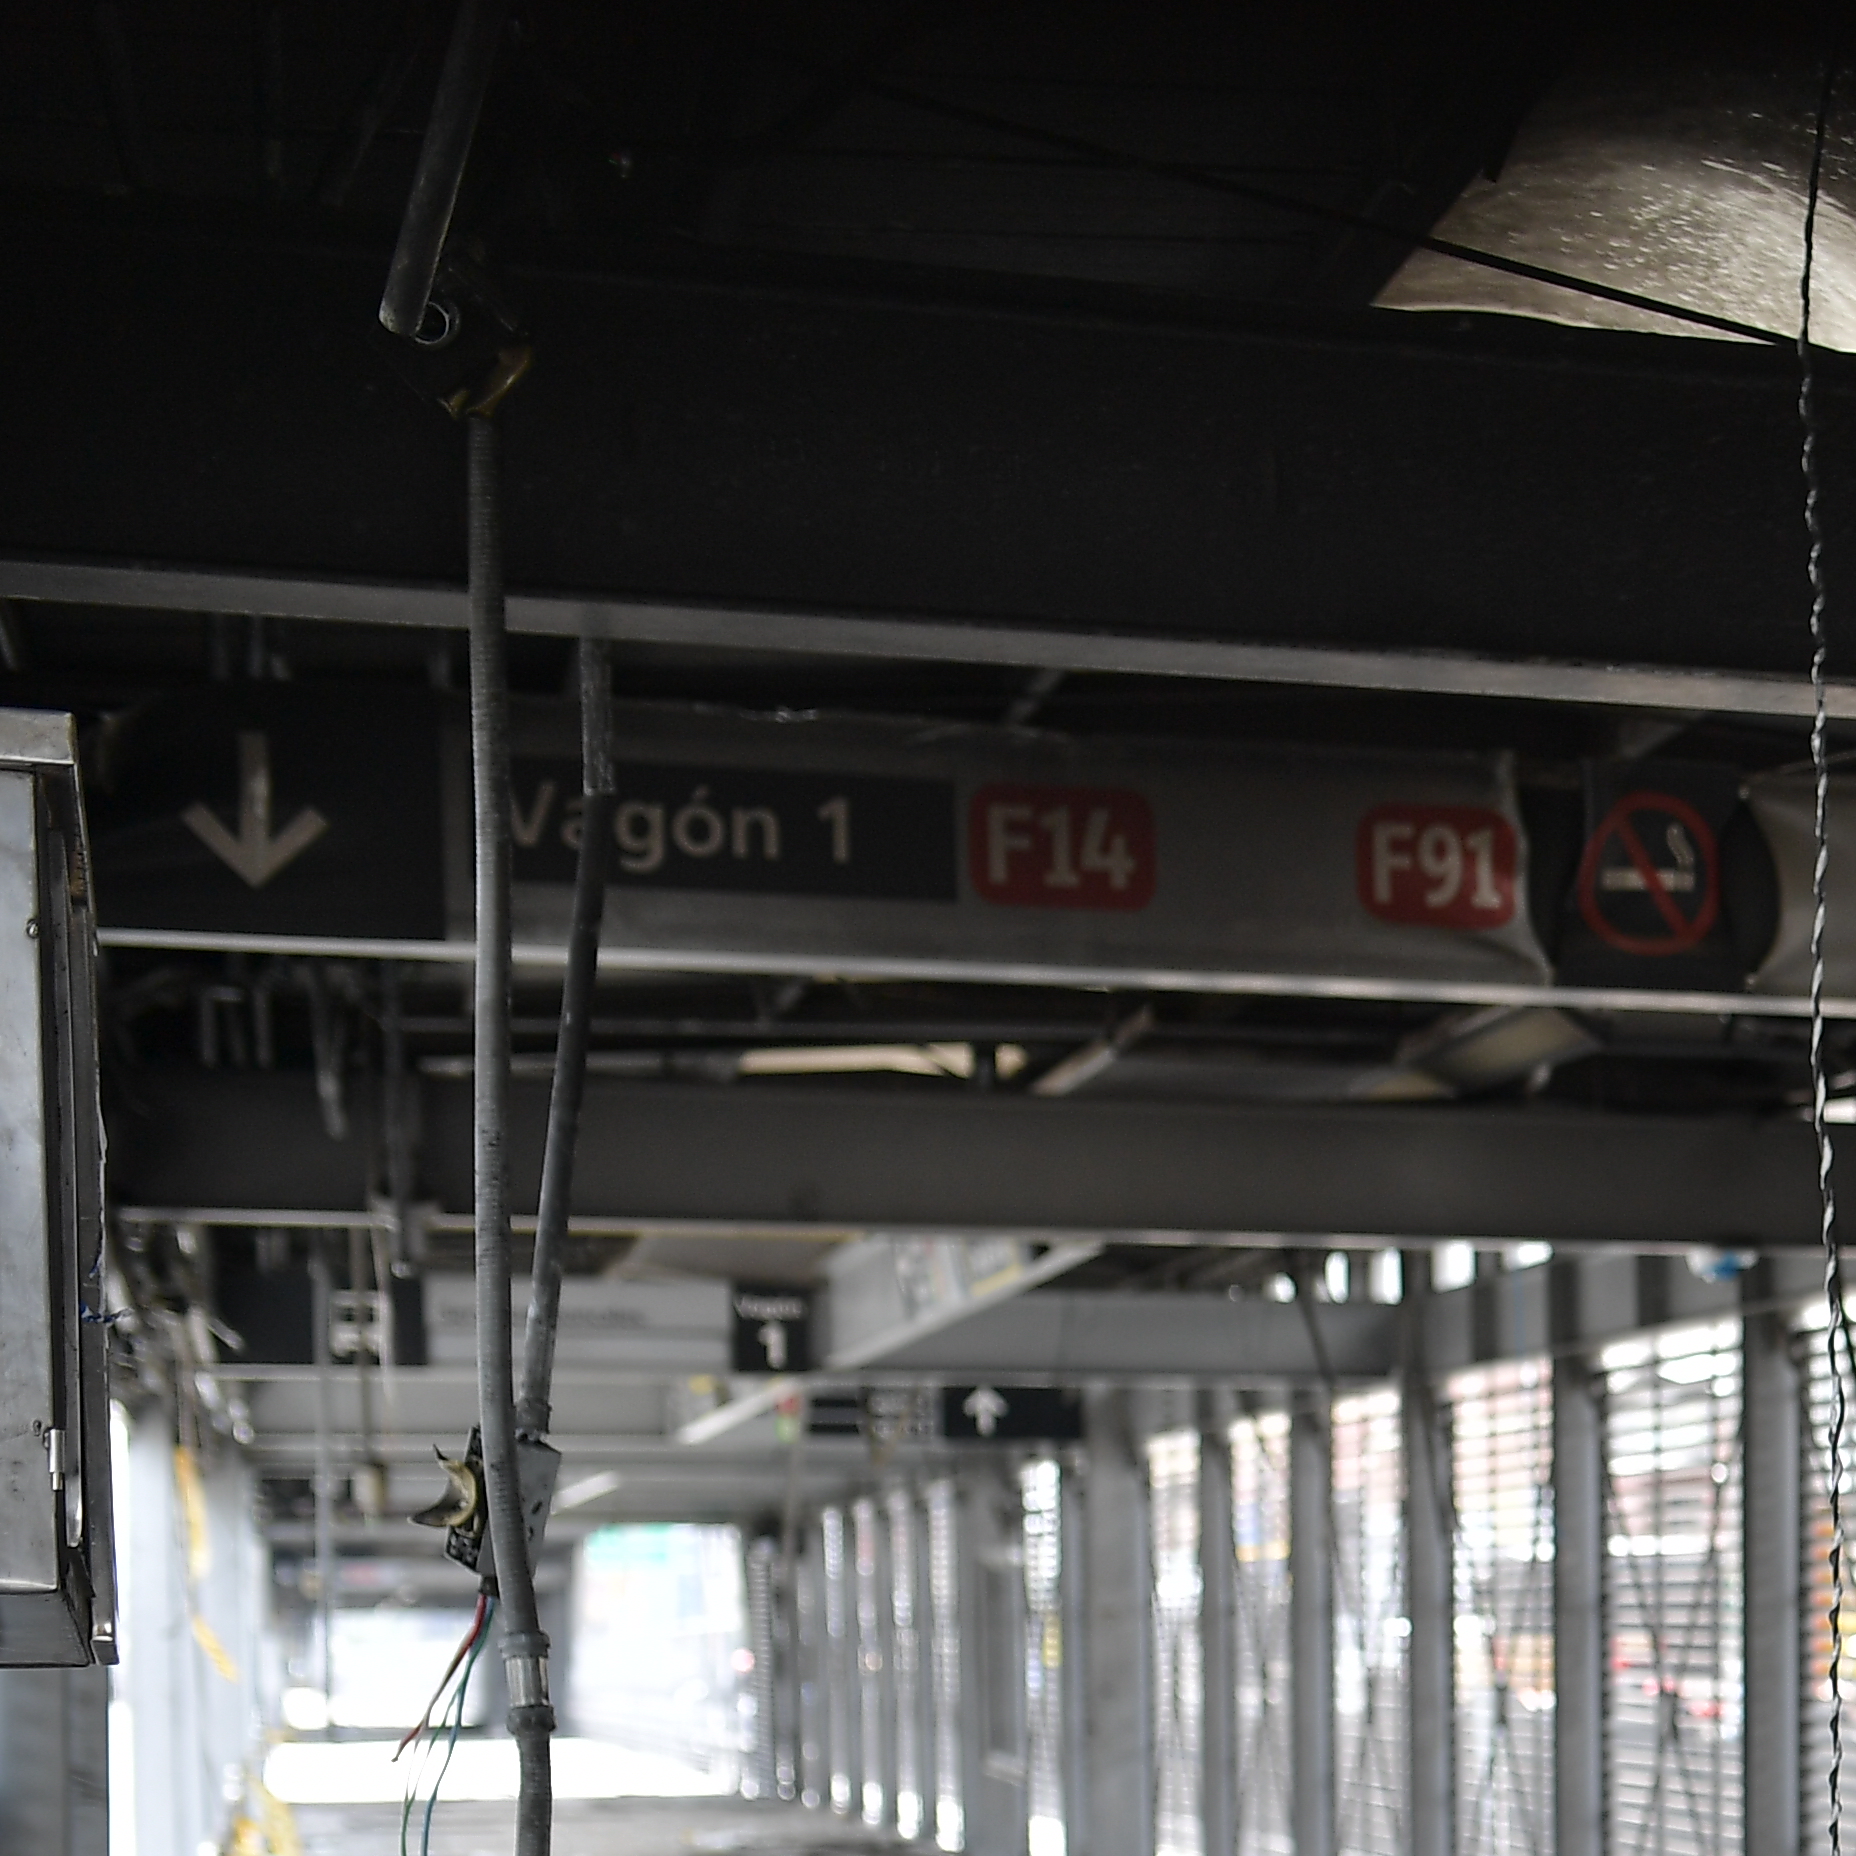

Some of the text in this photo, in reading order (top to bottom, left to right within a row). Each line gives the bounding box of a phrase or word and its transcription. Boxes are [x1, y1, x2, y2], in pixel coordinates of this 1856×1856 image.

[816, 797, 849, 864] 1
[986, 803, 1136, 892] F14
[1371, 822, 1502, 911] F91
